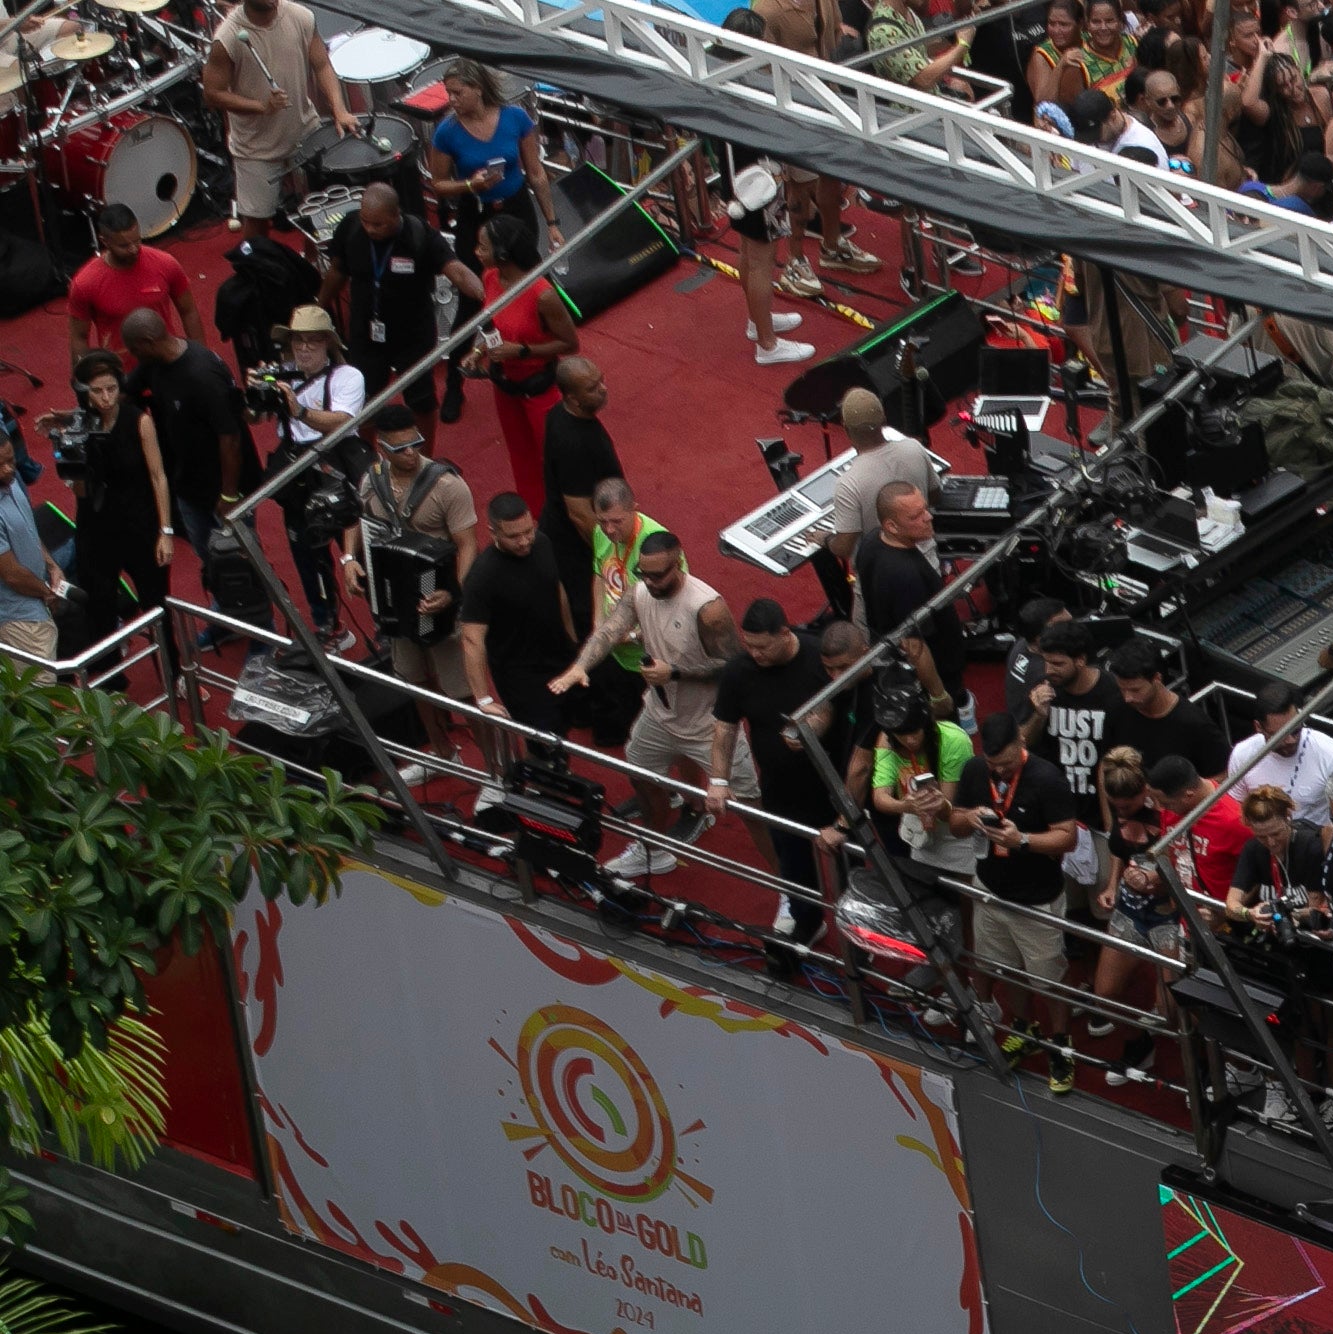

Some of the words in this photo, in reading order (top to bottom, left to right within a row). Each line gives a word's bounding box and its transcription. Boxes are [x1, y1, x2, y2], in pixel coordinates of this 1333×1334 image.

[1048, 705, 1106, 740] JUST
[1058, 737, 1098, 767] DO
[526, 1169, 615, 1234] BLOCO
[615, 1210, 634, 1232] DA
[637, 1213, 707, 1269] GOLD
[550, 1246, 581, 1267] com
[581, 1237, 618, 1280] Léo
[620, 1254, 704, 1317] Santana
[615, 1298, 654, 1330] 2024
